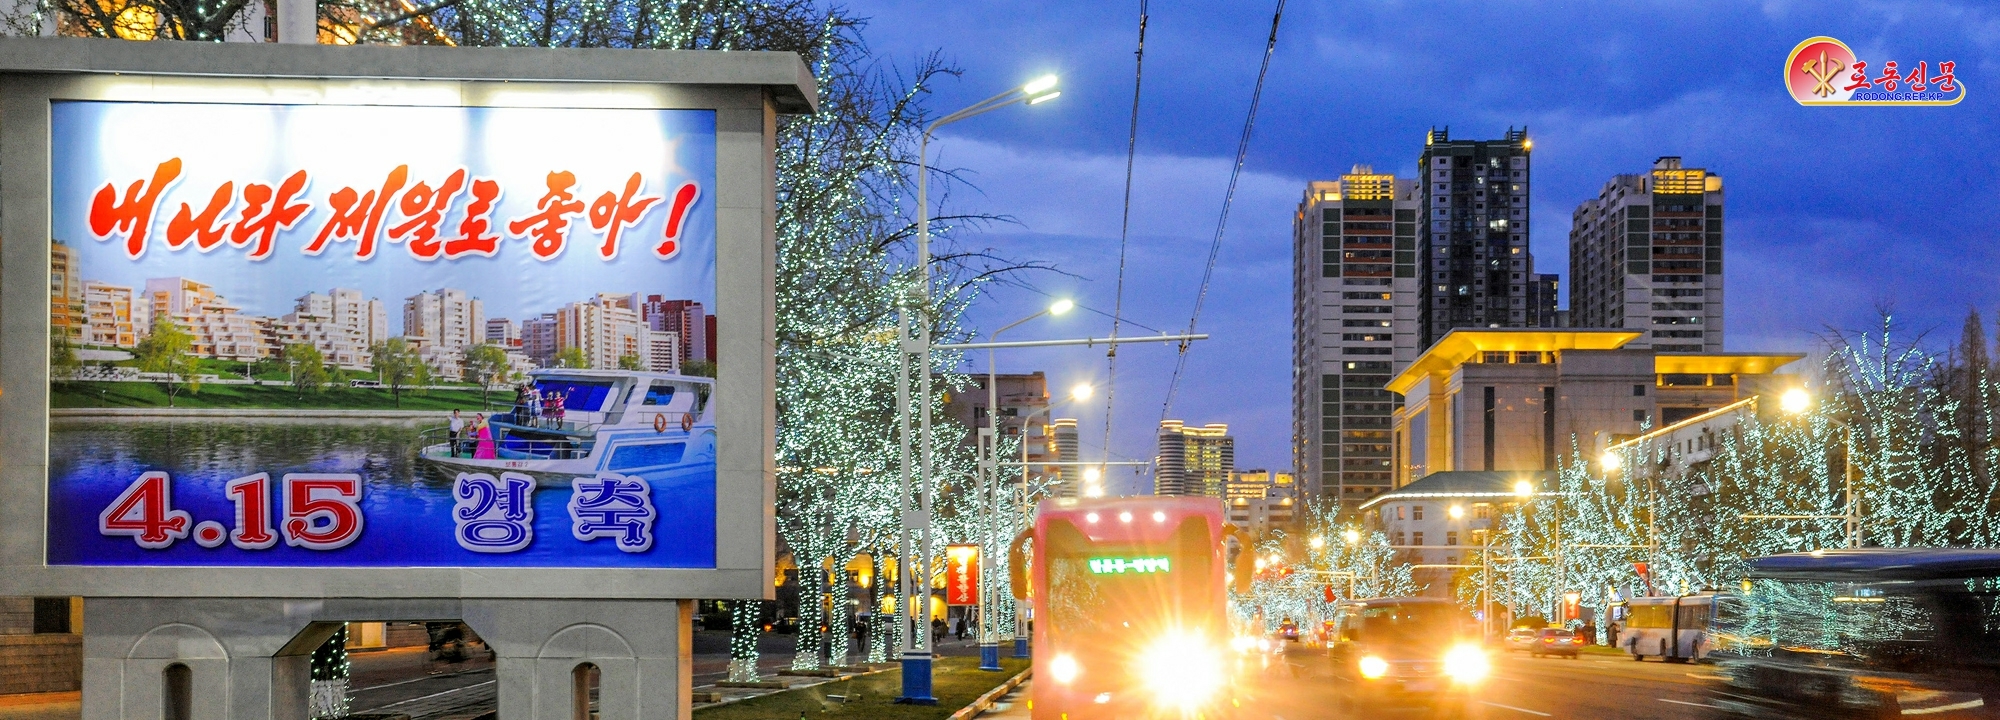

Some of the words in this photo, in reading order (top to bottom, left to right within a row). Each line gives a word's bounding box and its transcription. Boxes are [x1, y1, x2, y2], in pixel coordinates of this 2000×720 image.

[89, 157, 182, 256] 내
[166, 169, 310, 257] 나라
[303, 164, 500, 258] 제일로
[105, 476, 358, 544] 4.15
